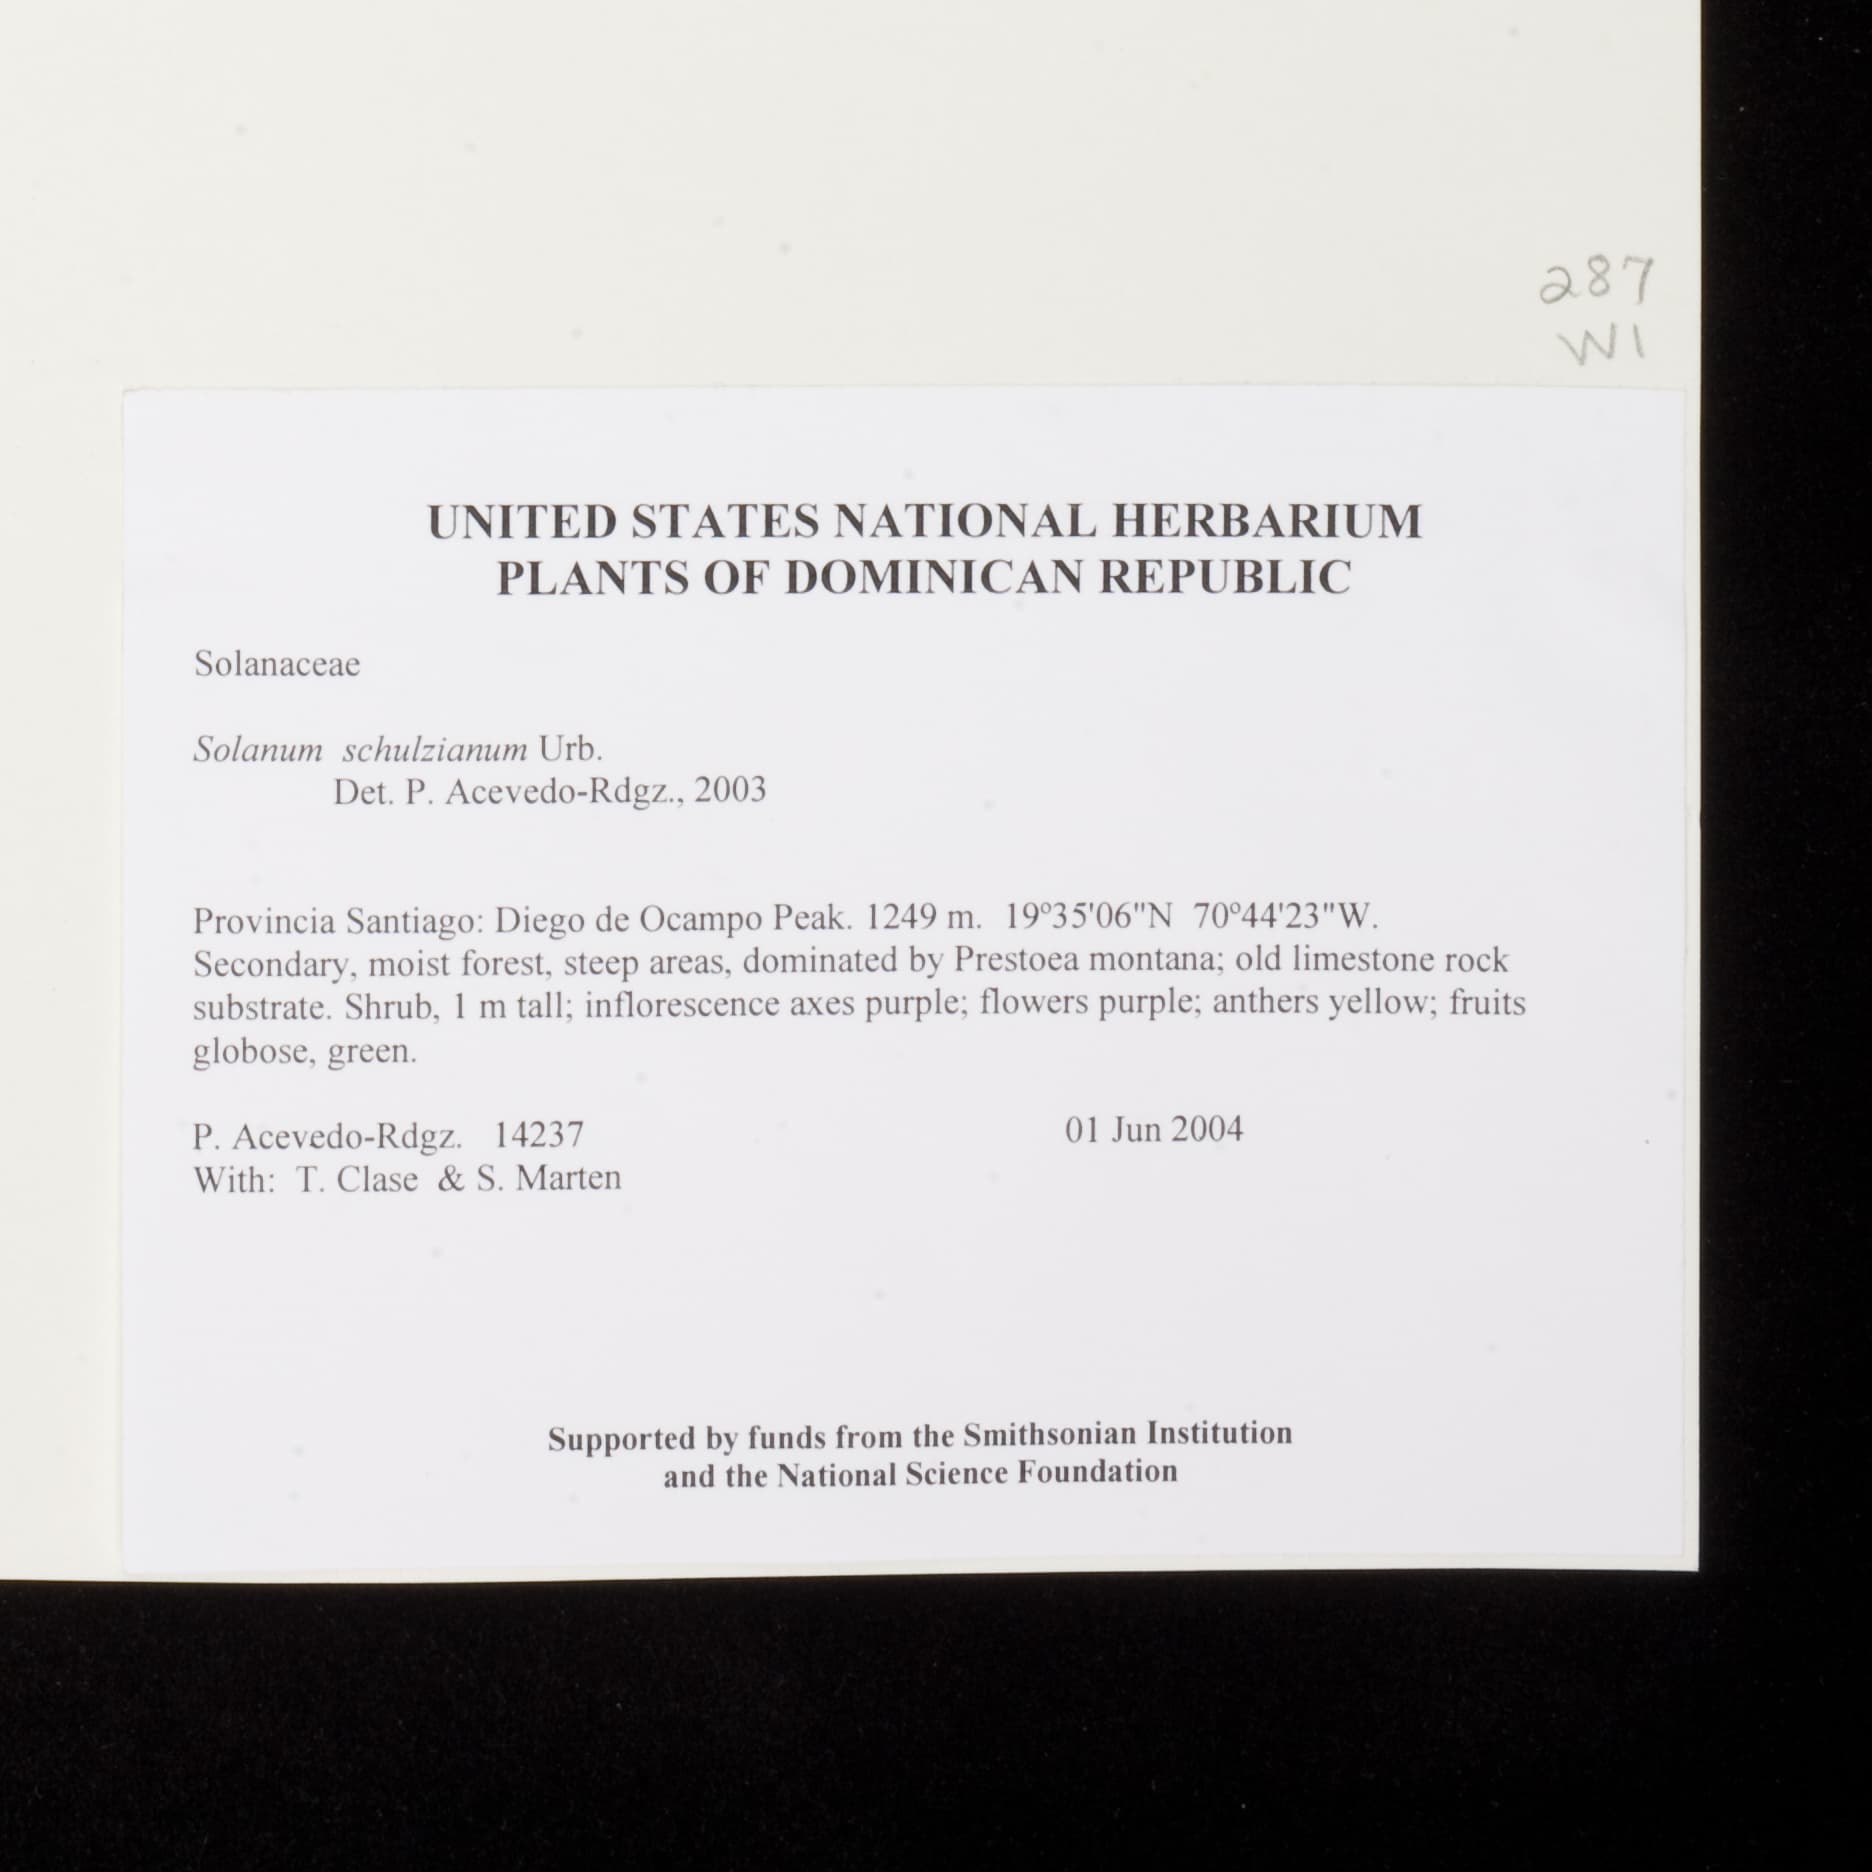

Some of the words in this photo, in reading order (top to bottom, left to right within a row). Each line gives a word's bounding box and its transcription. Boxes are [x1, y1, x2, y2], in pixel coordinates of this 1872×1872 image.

[1539, 253, 1655, 305] 287
[428, 503, 617, 540] UNITED
[632, 503, 820, 539] STATES
[834, 502, 1097, 538] NATIONAL
[1112, 502, 1422, 539] HERBARIUM
[497, 559, 689, 596] PLANTS
[704, 559, 770, 595] OF
[785, 558, 1084, 595] DOMINICAN
[1099, 559, 1352, 595] REPUBLIC
[195, 649, 361, 677] Solanaceae
[193, 734, 323, 763] Solanum
[342, 735, 528, 763] schulzianum
[539, 733, 602, 762] Urb.
[335, 777, 394, 806] Det.
[407, 778, 433, 805] P.
[445, 775, 684, 812] Acevedo-Rdgz.,
[694, 775, 766, 803] 2003
[194, 906, 337, 935] Provincia
[346, 906, 483, 941] Santiago:
[495, 905, 585, 941] Diego
[595, 904, 630, 933] de
[639, 904, 763, 939] Ocampo
[773, 902, 853, 931] Peak.
[869, 902, 937, 930] 1249
[947, 910, 982, 929] m.
[194, 949, 357, 985] Secondary,
[368, 949, 451, 977] moist
[461, 948, 552, 979] forest,
[564, 952, 639, 984] steep
[649, 954, 732, 980] areas,
[743, 945, 898, 974] dominated
[909, 944, 944, 980] by
[955, 945, 1080, 973] Prestoea
[1089, 948, 1225, 974] montana;
[1235, 943, 1282, 972] old
[1293, 943, 1435, 973] limestone
[1445, 945, 1509, 973] rock
[193, 992, 332, 1021] substrate.
[345, 991, 440, 1024] Shrub,
[455, 992, 465, 1020] 1
[479, 999, 507, 1019] m
[516, 991, 573, 1023] tall;
[585, 990, 780, 1019] inflorescence
[790, 996, 855, 1017] axes
[865, 987, 968, 1024] purple;
[980, 986, 1089, 1015] flowers
[1099, 985, 1202, 1022] purple;
[1213, 986, 1319, 1015] anthers
[1328, 986, 1437, 1022] yellow;
[1449, 987, 1527, 1016] fruits
[192, 1036, 316, 1072] globose,
[327, 1043, 417, 1072] green.
[193, 1123, 220, 1151] P.
[232, 1121, 462, 1157] Acevedo-Rdgz.
[497, 1120, 584, 1149] 14237
[1065, 1115, 1097, 1144] 01
[1111, 1115, 1162, 1143] Jun
[1171, 1114, 1245, 1143] 2004
[193, 1165, 275, 1194] With:
[295, 1165, 325, 1193] T.
[337, 1164, 419, 1193] Clase
[437, 1164, 465, 1193] &
[477, 1163, 504, 1192] S.
[516, 1163, 622, 1192] Marten
[548, 1425, 696, 1458] Supported
[706, 1425, 739, 1457] by
[748, 1424, 826, 1450] funds
[835, 1424, 903, 1449] from
[912, 1423, 955, 1449] the
[963, 1420, 1137, 1447] Smithsonian
[1147, 1419, 1293, 1445] Institution
[663, 1463, 715, 1489] and
[725, 1463, 768, 1489] the
[777, 1461, 897, 1488] National
[905, 1460, 1009, 1486] Science
[1018, 1457, 1178, 1484] Foundation
